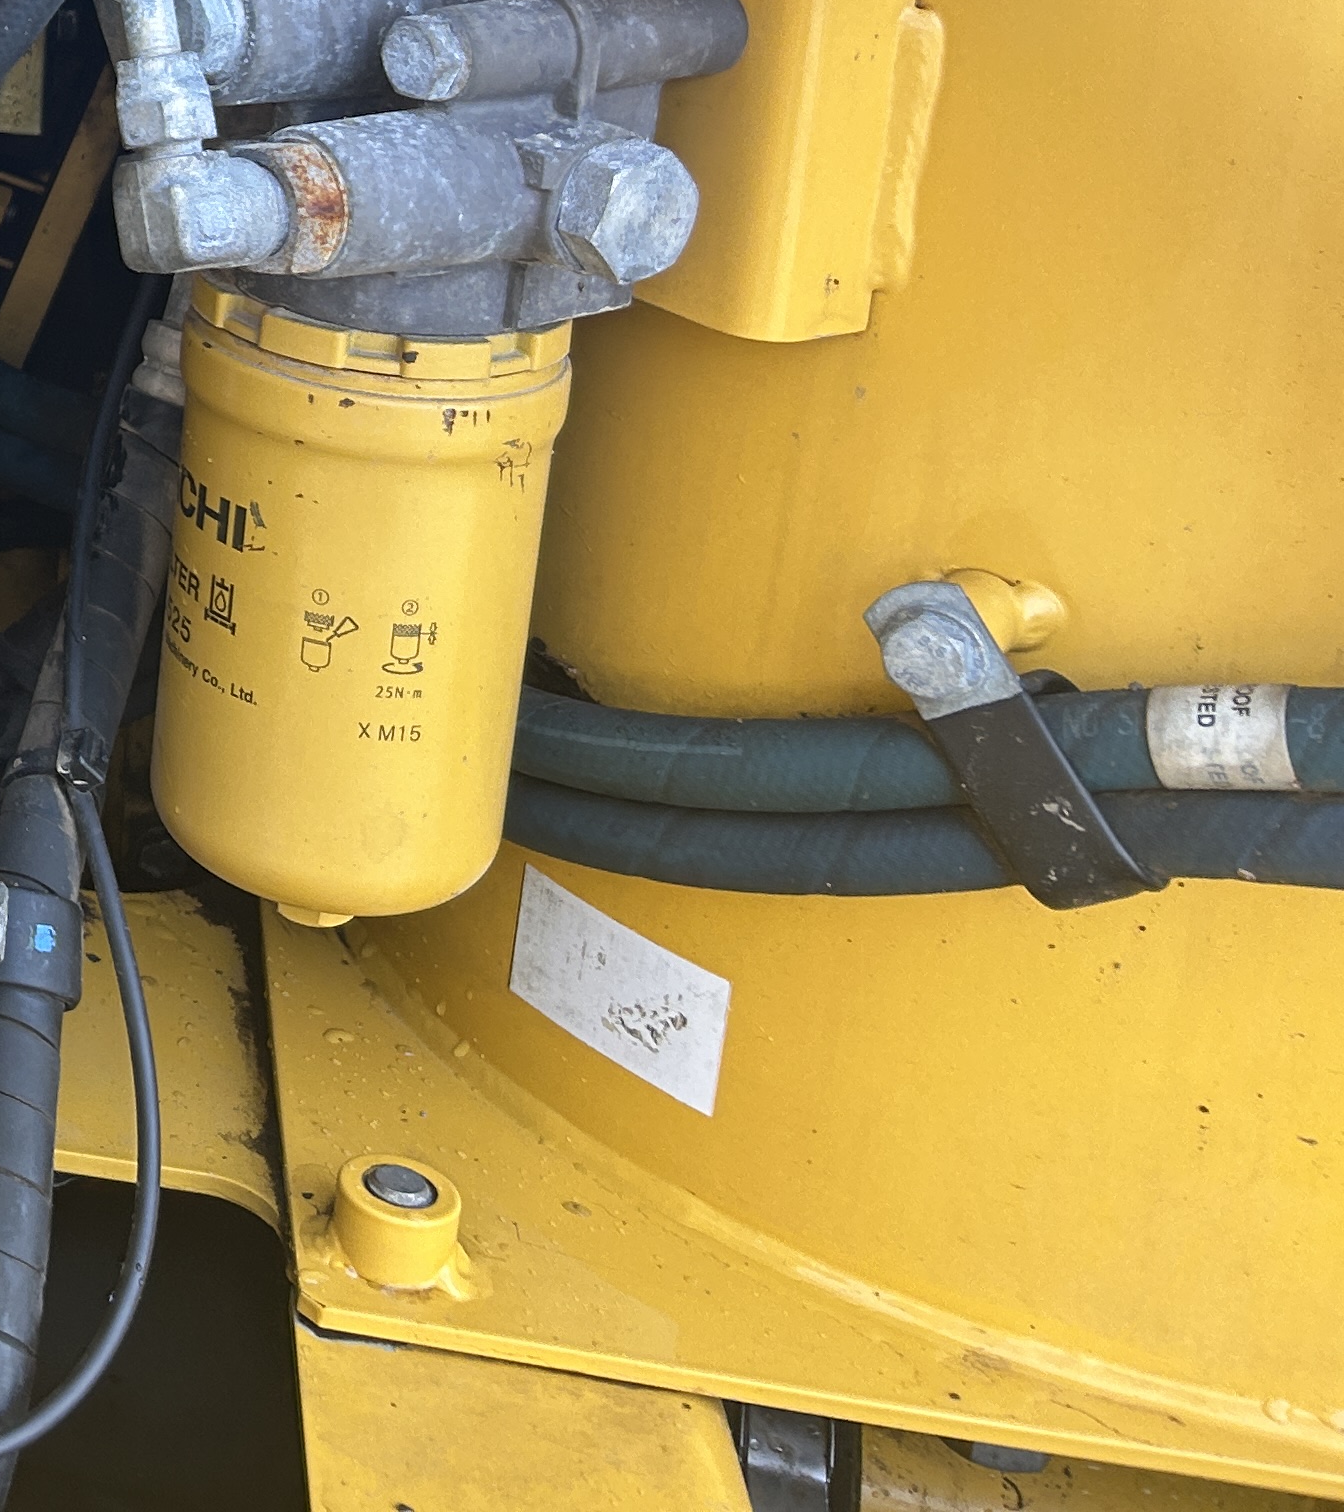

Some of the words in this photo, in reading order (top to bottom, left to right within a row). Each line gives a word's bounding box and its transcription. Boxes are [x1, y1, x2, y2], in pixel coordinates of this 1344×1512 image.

[202, 668, 225, 693] Co.,
[230, 682, 258, 706] Ltd.
[358, 721, 372, 739] X
[377, 724, 422, 742] M15
